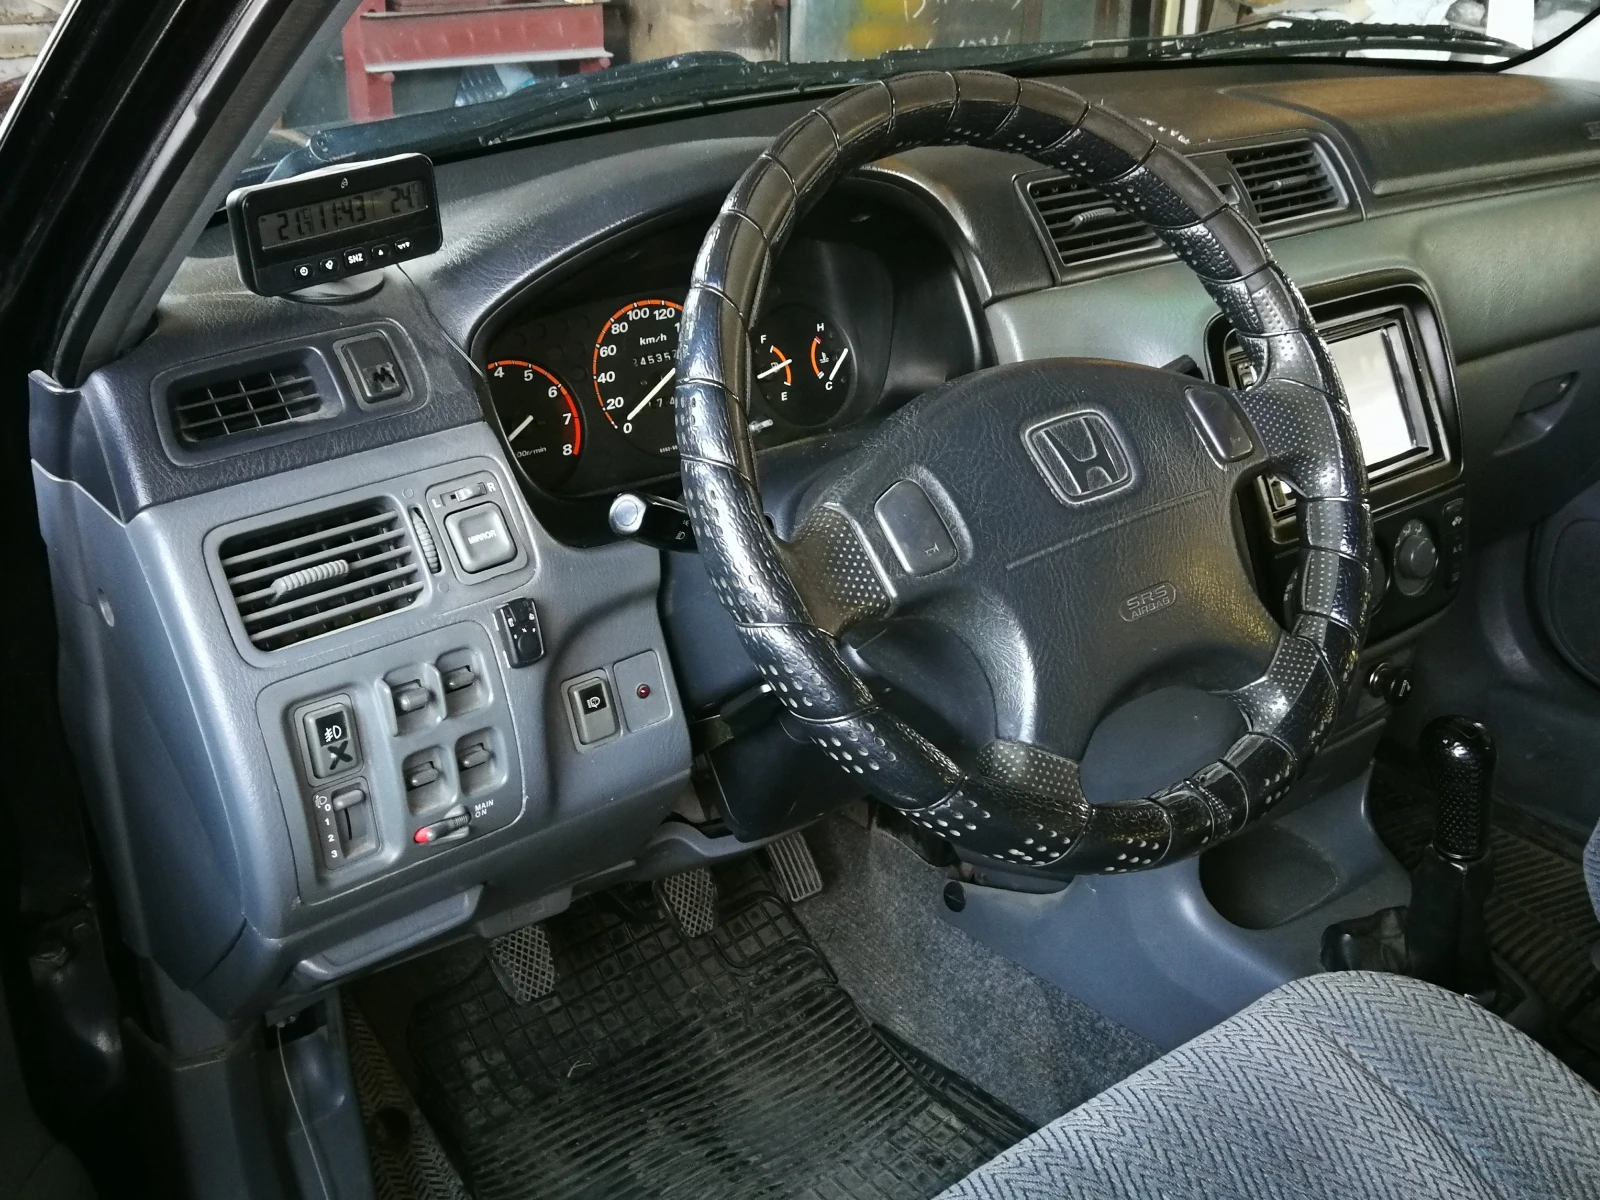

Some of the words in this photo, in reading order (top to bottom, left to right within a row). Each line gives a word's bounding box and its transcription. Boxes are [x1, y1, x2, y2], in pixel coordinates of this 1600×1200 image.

[347, 252, 364, 264] SNZ
[626, 307, 650, 321] 100
[653, 307, 675, 321] 120
[611, 321, 629, 335] 80
[816, 322, 825, 332] H
[639, 332, 667, 346] km/h
[760, 334, 767, 344] F
[599, 344, 617, 358] 60
[493, 366, 505, 378] 4
[523, 369, 534, 382] 5
[597, 370, 616, 384] 40
[547, 386, 558, 398] 6
[825, 381, 833, 391] C
[780, 391, 788, 401] E
[606, 396, 624, 411] 20
[562, 412, 572, 425] 7
[622, 422, 633, 434] 0
[562, 443, 573, 456] 8
[486, 482, 496, 492] R
[431, 498, 441, 509] L
[467, 529, 496, 545] MIRROR
[1126, 584, 1168, 611] SRS
[1131, 596, 1171, 619] AIRBAG
[324, 803, 332, 812] 0
[474, 799, 494, 812] MAIN
[475, 808, 487, 818] ON
[324, 817, 330, 826] 1
[327, 833, 335, 843] 2
[331, 849, 338, 859] 3
